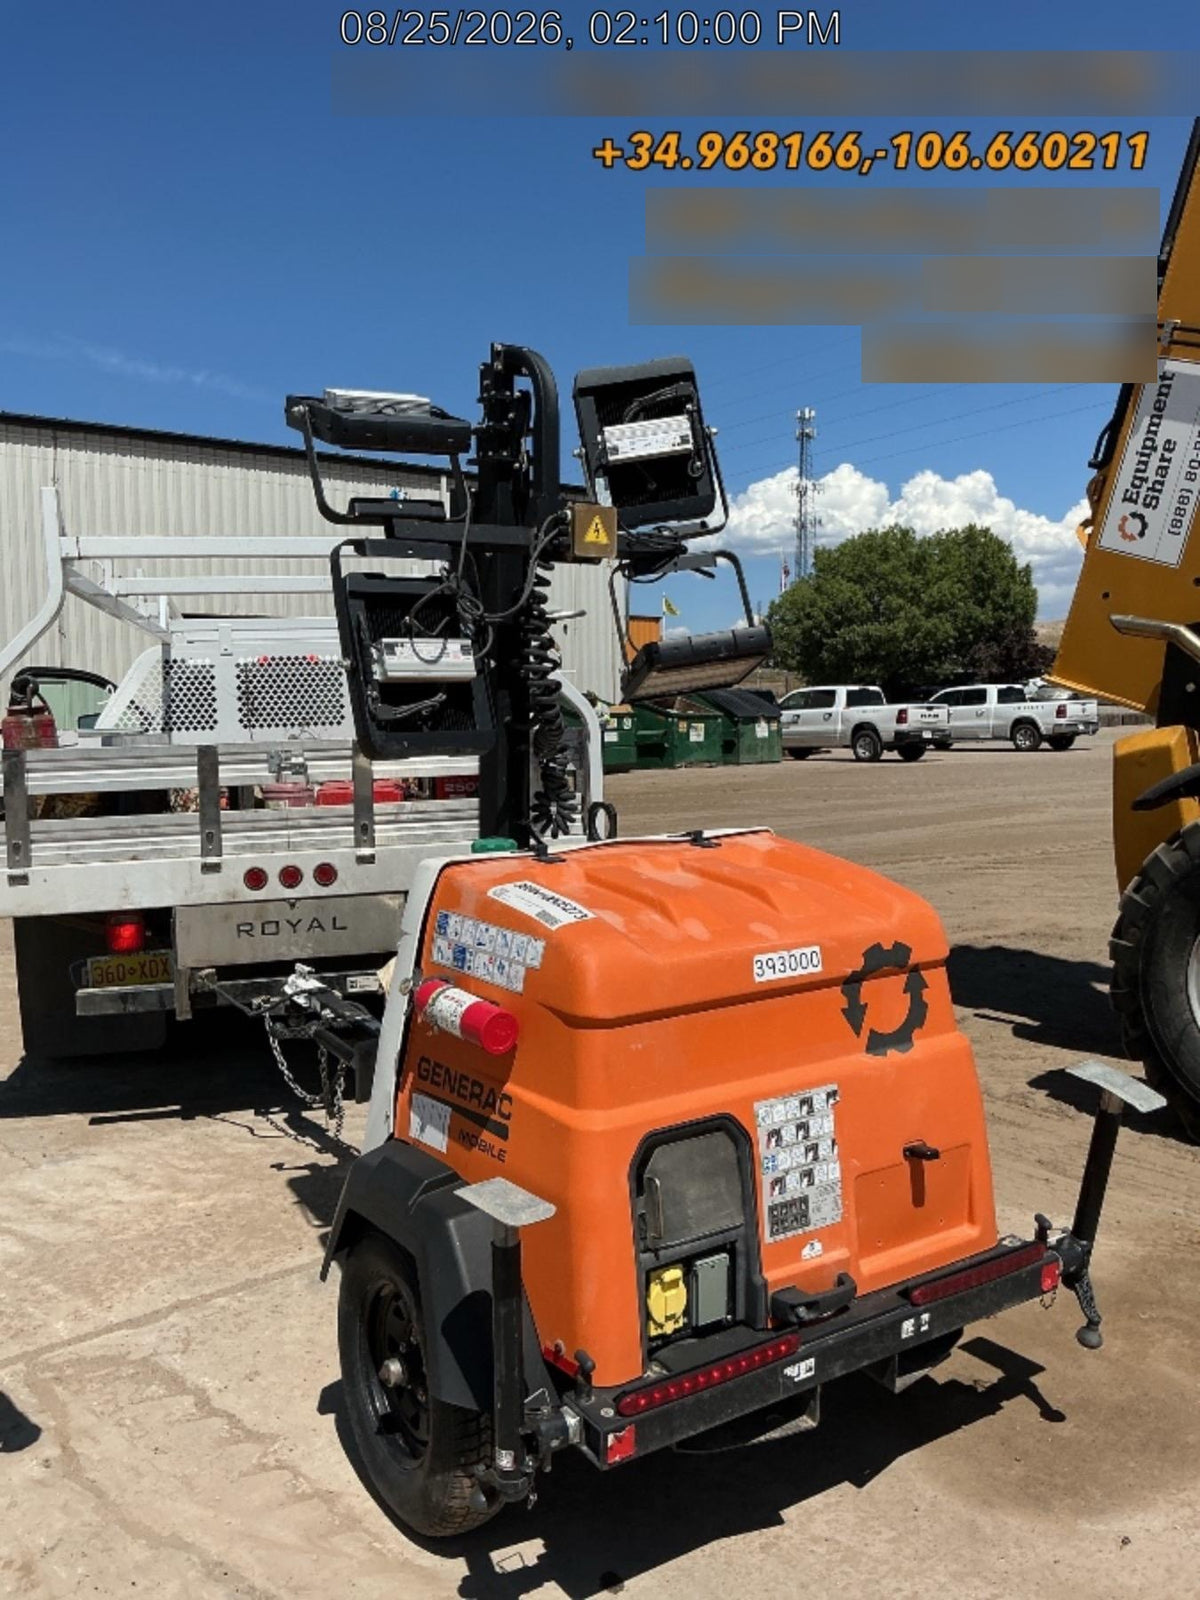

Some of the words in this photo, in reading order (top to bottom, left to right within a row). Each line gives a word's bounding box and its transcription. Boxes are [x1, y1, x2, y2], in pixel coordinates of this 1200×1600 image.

[1121, 370, 1176, 506] Equipment
[1142, 438, 1177, 511] Share
[1168, 488, 1195, 536] (888)
[236, 916, 348, 938] ROYAL
[755, 950, 821, 978] 393000
[417, 1056, 513, 1121] GENERAC
[458, 1129, 507, 1163] MOBILE
